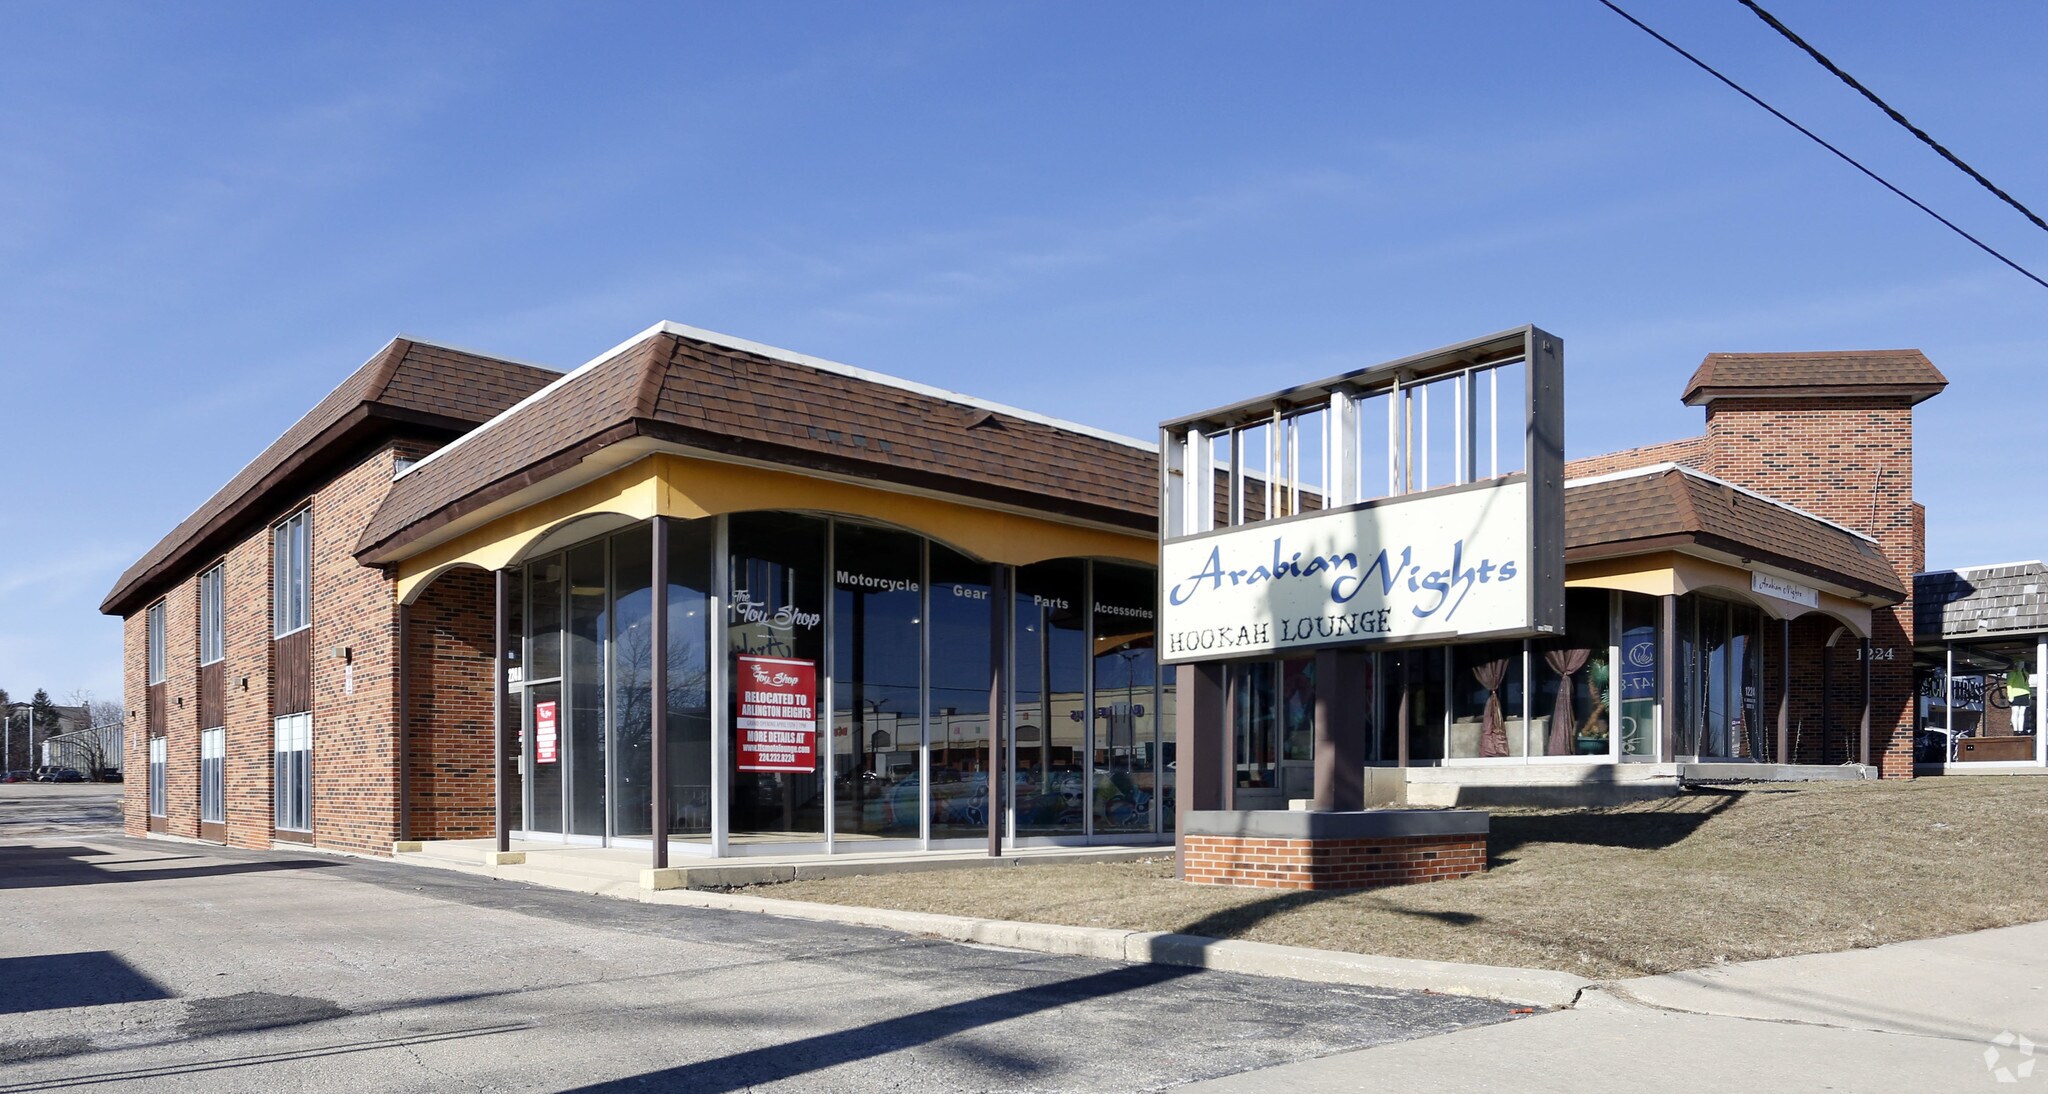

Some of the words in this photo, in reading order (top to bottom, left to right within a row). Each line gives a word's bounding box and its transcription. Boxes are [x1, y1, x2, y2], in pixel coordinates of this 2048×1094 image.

[836, 570, 919, 593] Motorcycle
[1169, 537, 1358, 606] Arabian
[1331, 539, 1517, 621] Nights
[1759, 576, 1781, 591] Arabian
[732, 590, 750, 602] The
[953, 585, 987, 600] Gear
[1034, 595, 1069, 609] Parts
[737, 602, 779, 627] Toy
[774, 605, 820, 630] Shop
[1094, 602, 1154, 619] Accessories
[1169, 622, 1270, 653] HOOKAH
[1281, 608, 1393, 643] LOUNGE
[753, 670, 775, 685] Toy
[773, 672, 799, 686] Shop
[745, 691, 794, 705] RELOCATED
[795, 694, 807, 706] TO
[742, 704, 781, 717] ARLINGTON
[782, 706, 811, 719] HEIGHTS
[747, 730, 768, 742] MORE
[769, 732, 795, 744] DETAILS
[796, 733, 805, 744] AT
